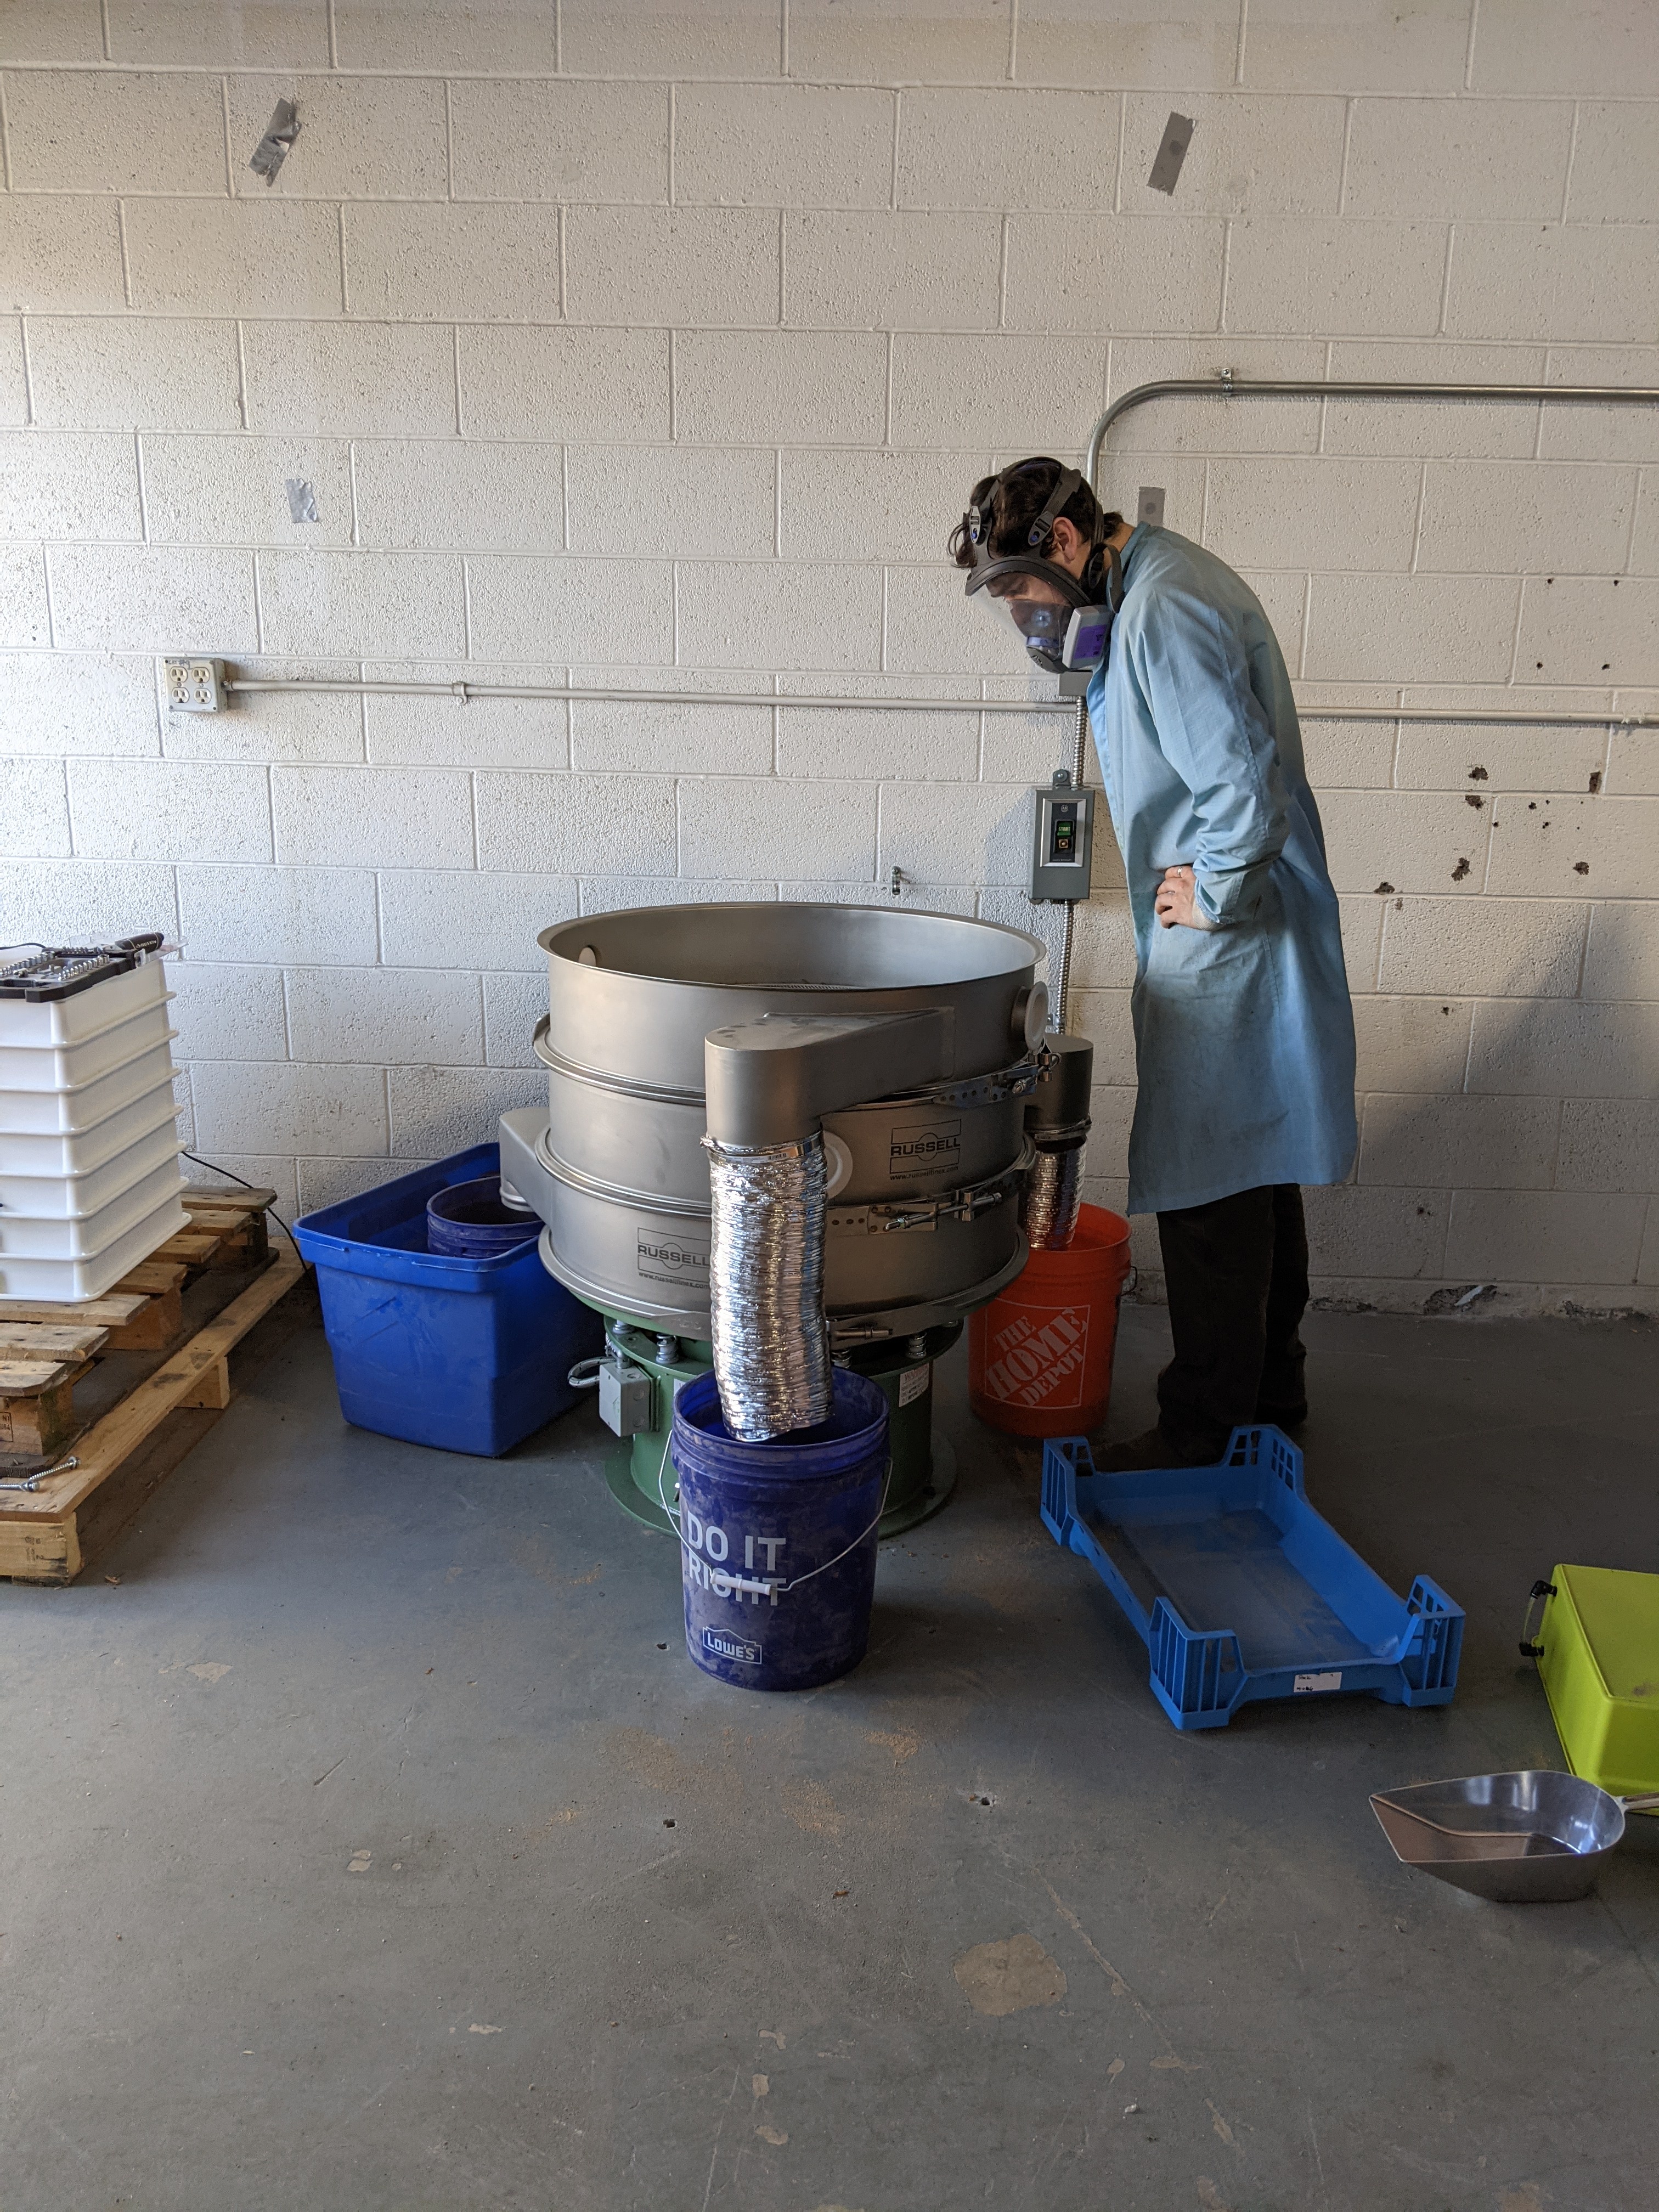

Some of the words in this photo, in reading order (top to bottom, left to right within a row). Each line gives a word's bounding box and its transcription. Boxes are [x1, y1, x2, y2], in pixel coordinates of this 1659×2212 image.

[891, 1137, 960, 1156] RUSSELL
[890, 1166, 958, 1180] www.russellfinex.com
[637, 1244, 710, 1266] RUSSELL
[994, 1316, 1037, 1352] THE
[986, 1307, 1087, 1399] HOME
[1019, 1344, 1084, 1406] DEPOT
[687, 1510, 729, 1561] DO
[745, 1535, 786, 1571] IT
[707, 1632, 755, 1660] LOWE'S
